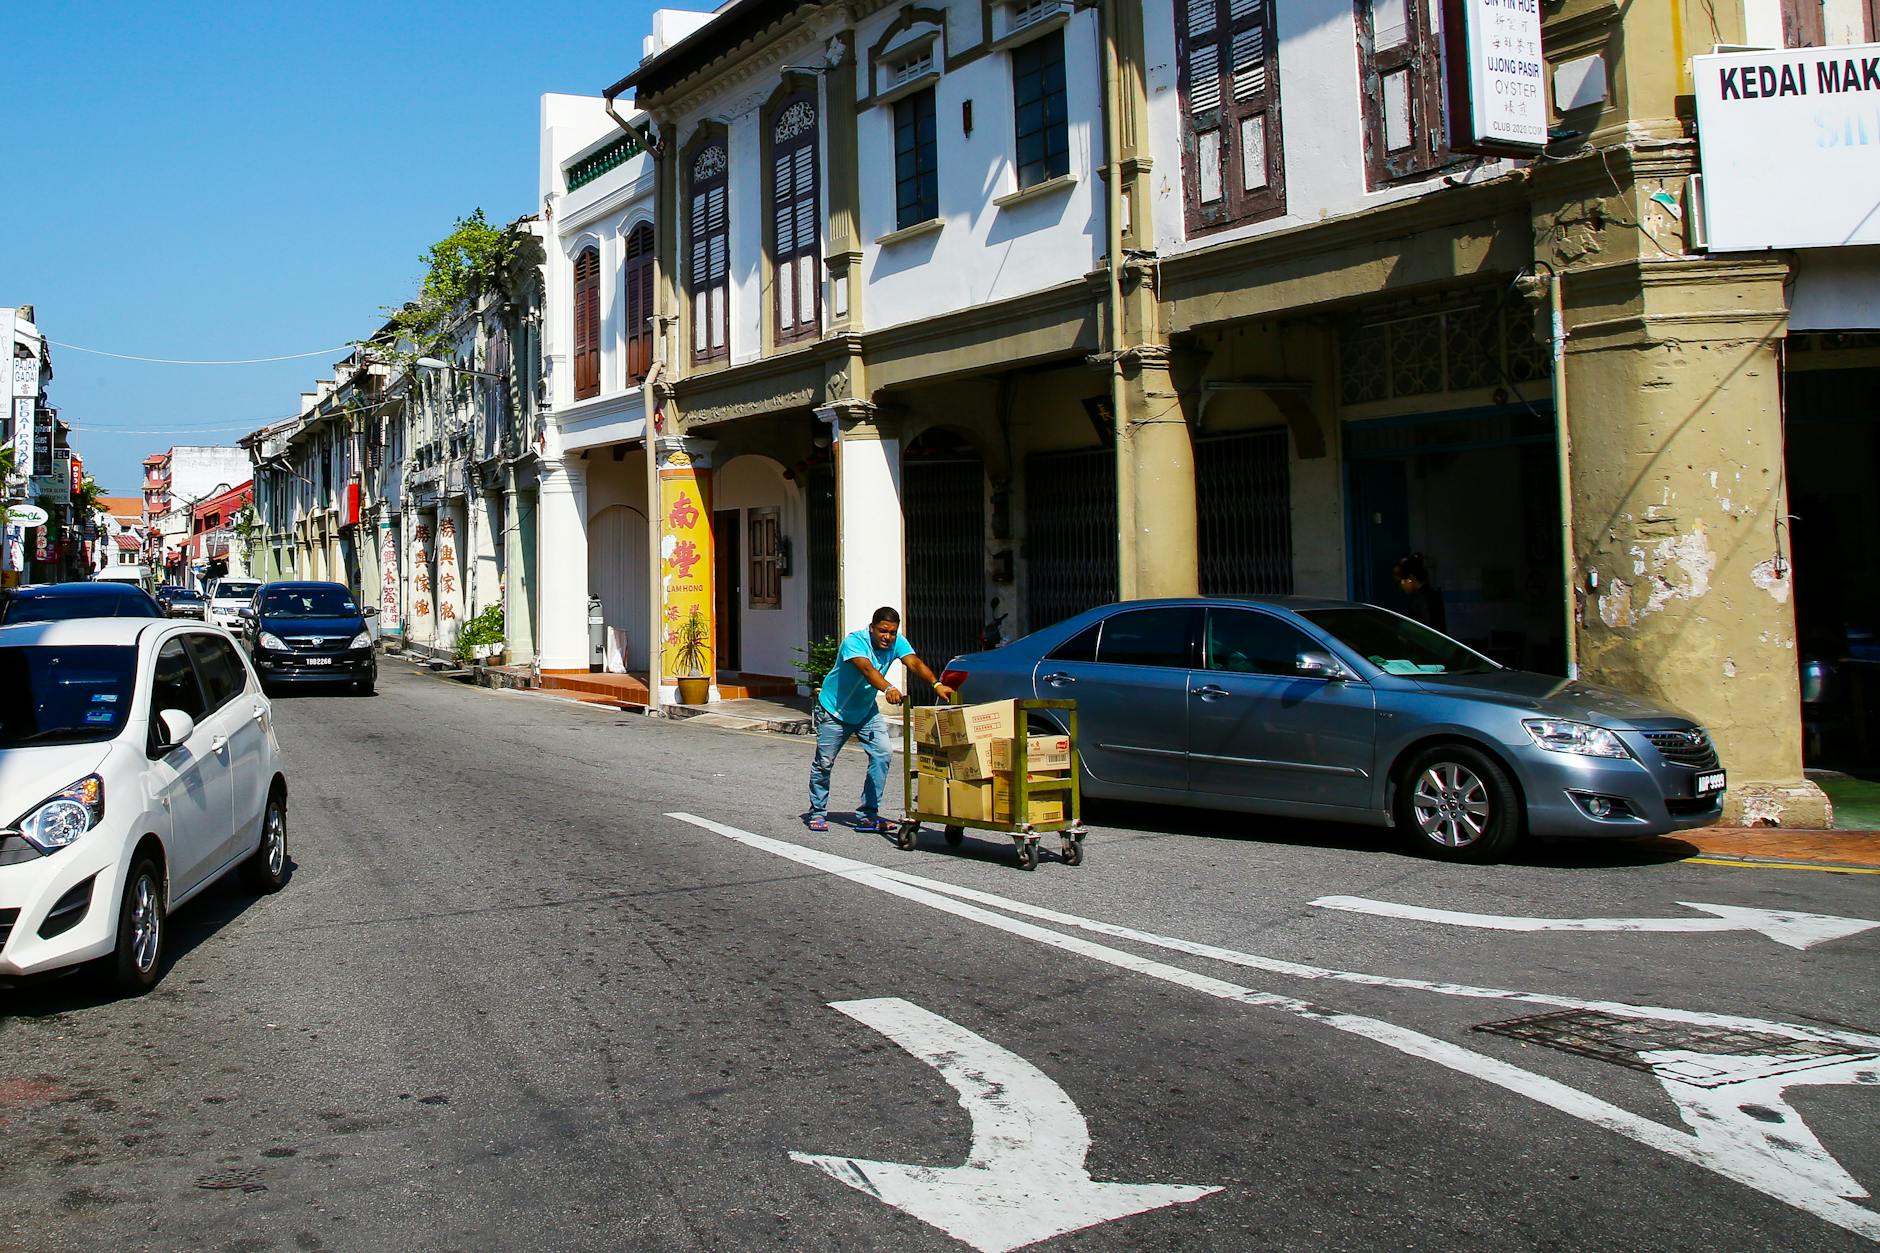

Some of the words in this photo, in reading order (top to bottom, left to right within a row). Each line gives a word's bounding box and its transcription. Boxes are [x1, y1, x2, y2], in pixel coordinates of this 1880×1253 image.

[1488, 57, 1516, 74] UJONG
[1518, 61, 1540, 78] PASIR
[1719, 63, 1807, 100] KEDAI
[1816, 58, 1880, 94] MAK
[1495, 79, 1537, 98] OYSTER
[1493, 121, 1511, 132] CLUB
[15, 360, 38, 371] PAJAK
[15, 371, 37, 382] GADAI
[20, 399, 30, 430] KEDAI
[667, 585, 682, 593] LAM
